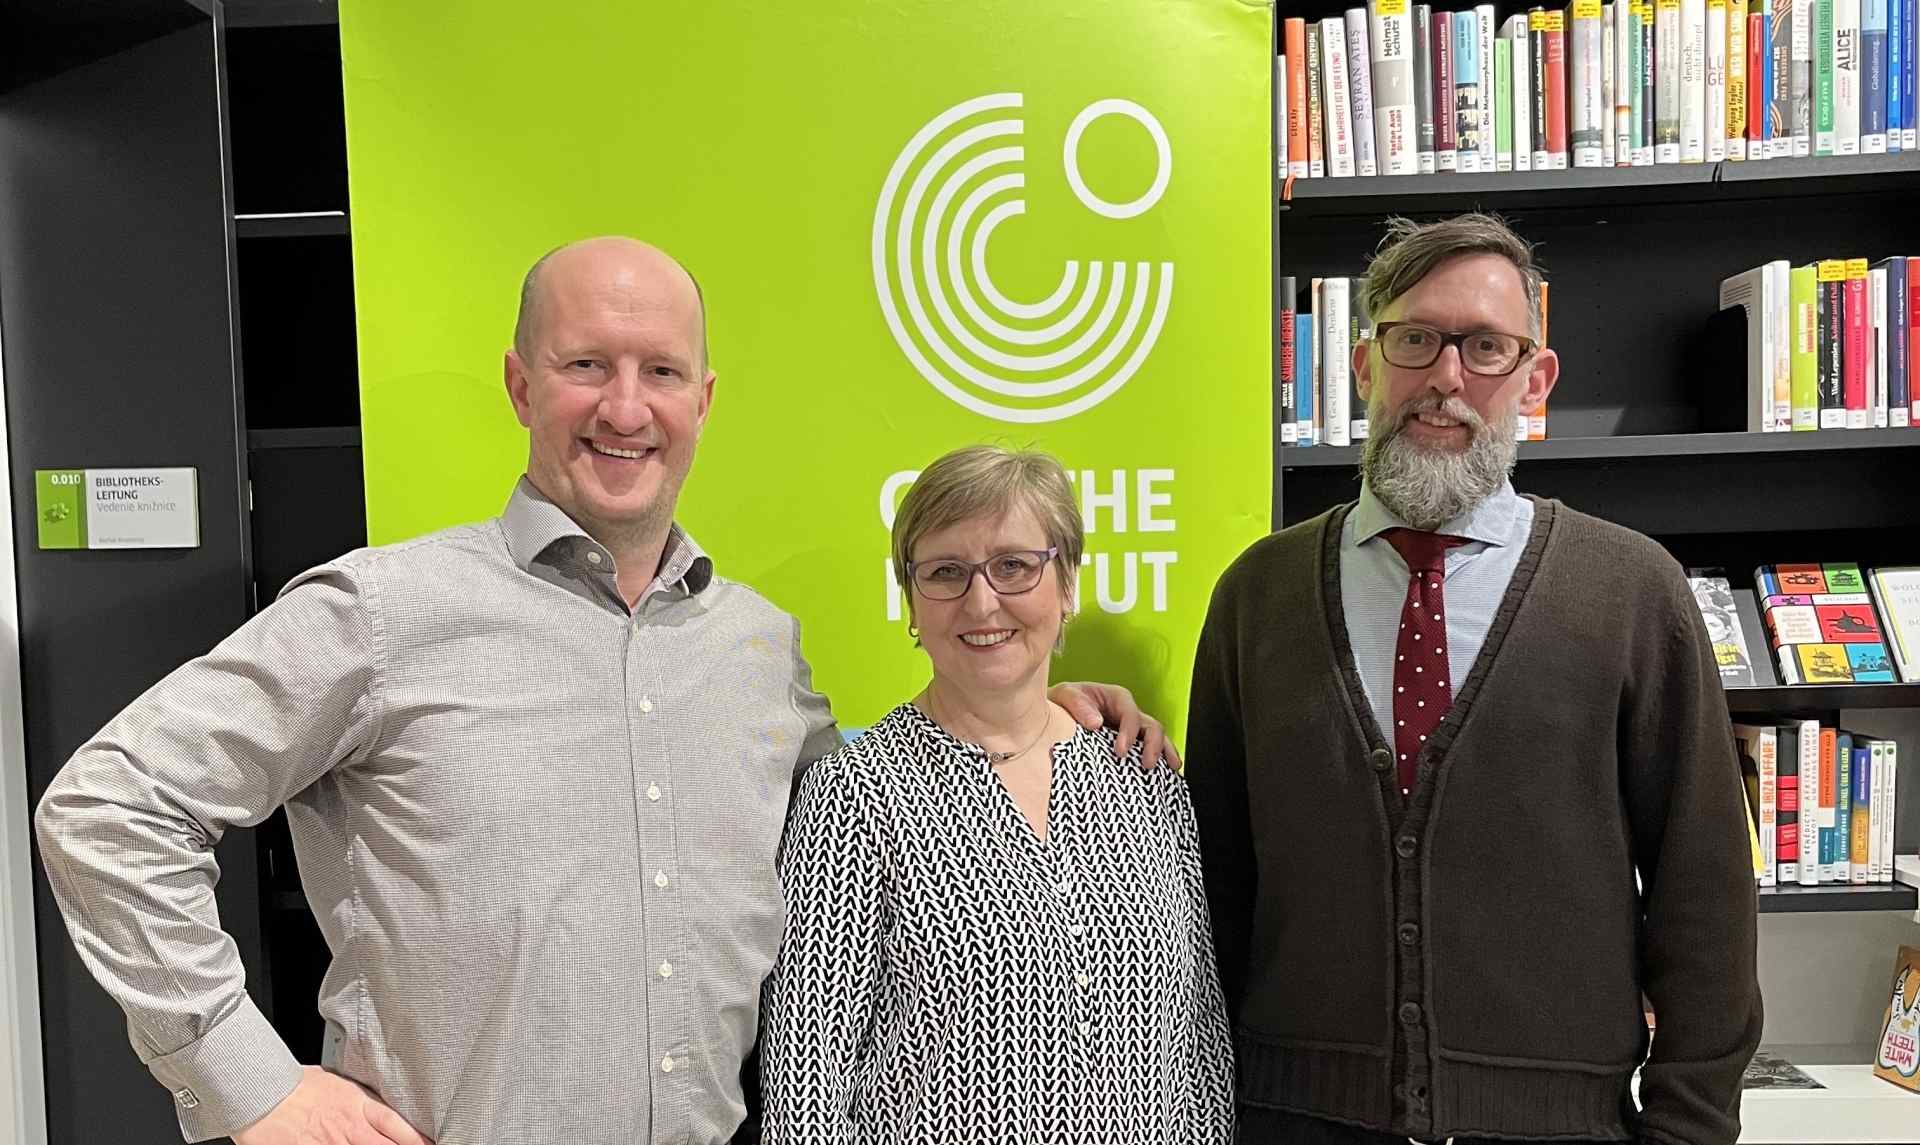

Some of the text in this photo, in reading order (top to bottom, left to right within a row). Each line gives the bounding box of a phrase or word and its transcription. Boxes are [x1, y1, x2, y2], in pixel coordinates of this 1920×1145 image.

[1383, 16, 1392, 56] Heimat
[1392, 20, 1400, 56] schutz
[1837, 28, 1851, 70] ALICE
[1336, 104, 1346, 141] WAHRHEIT
[96, 476, 164, 487] BIBLIOTHEKS-
[96, 490, 138, 500] LEITUNG
[96, 502, 135, 512] Vedenie
[1888, 1033, 1914, 1052] TEETH
[1885, 1047, 1912, 1068] WHITE
